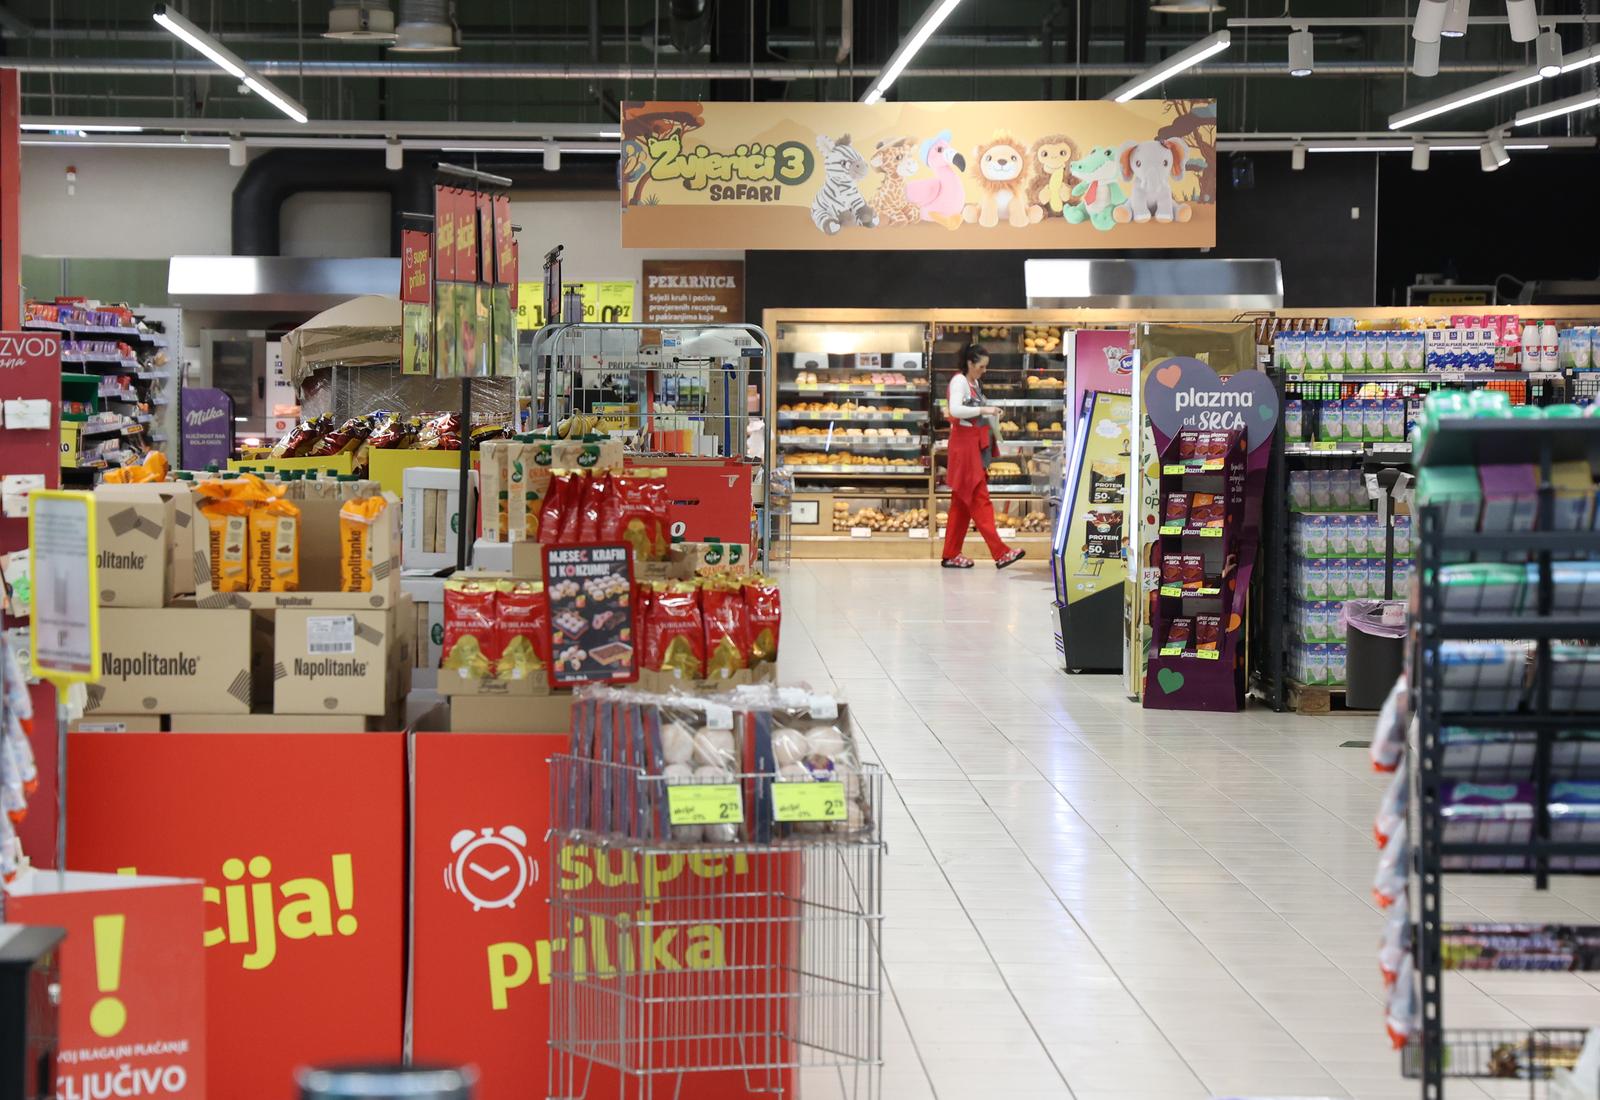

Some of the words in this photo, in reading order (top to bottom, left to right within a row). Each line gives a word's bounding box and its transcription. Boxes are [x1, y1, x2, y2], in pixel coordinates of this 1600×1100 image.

[781, 147, 805, 179] 3
[710, 184, 781, 202] SAFARI
[648, 275, 736, 288] PEKARNICA
[1176, 387, 1253, 412] plazma
[186, 406, 225, 427] Milka
[1183, 414, 1196, 426] od
[1198, 411, 1246, 431] SRCA
[549, 549, 588, 563] MJESEC
[549, 565, 557, 577] U
[276, 596, 312, 608] Napolitanke
[101, 651, 197, 683] Napolitanke
[294, 658, 366, 683] Napolitanke
[719, 803, 729, 819] 2
[824, 800, 835, 816] 2
[557, 844, 750, 904] super
[203, 853, 358, 971] cija!
[487, 909, 726, 1011] prilika
